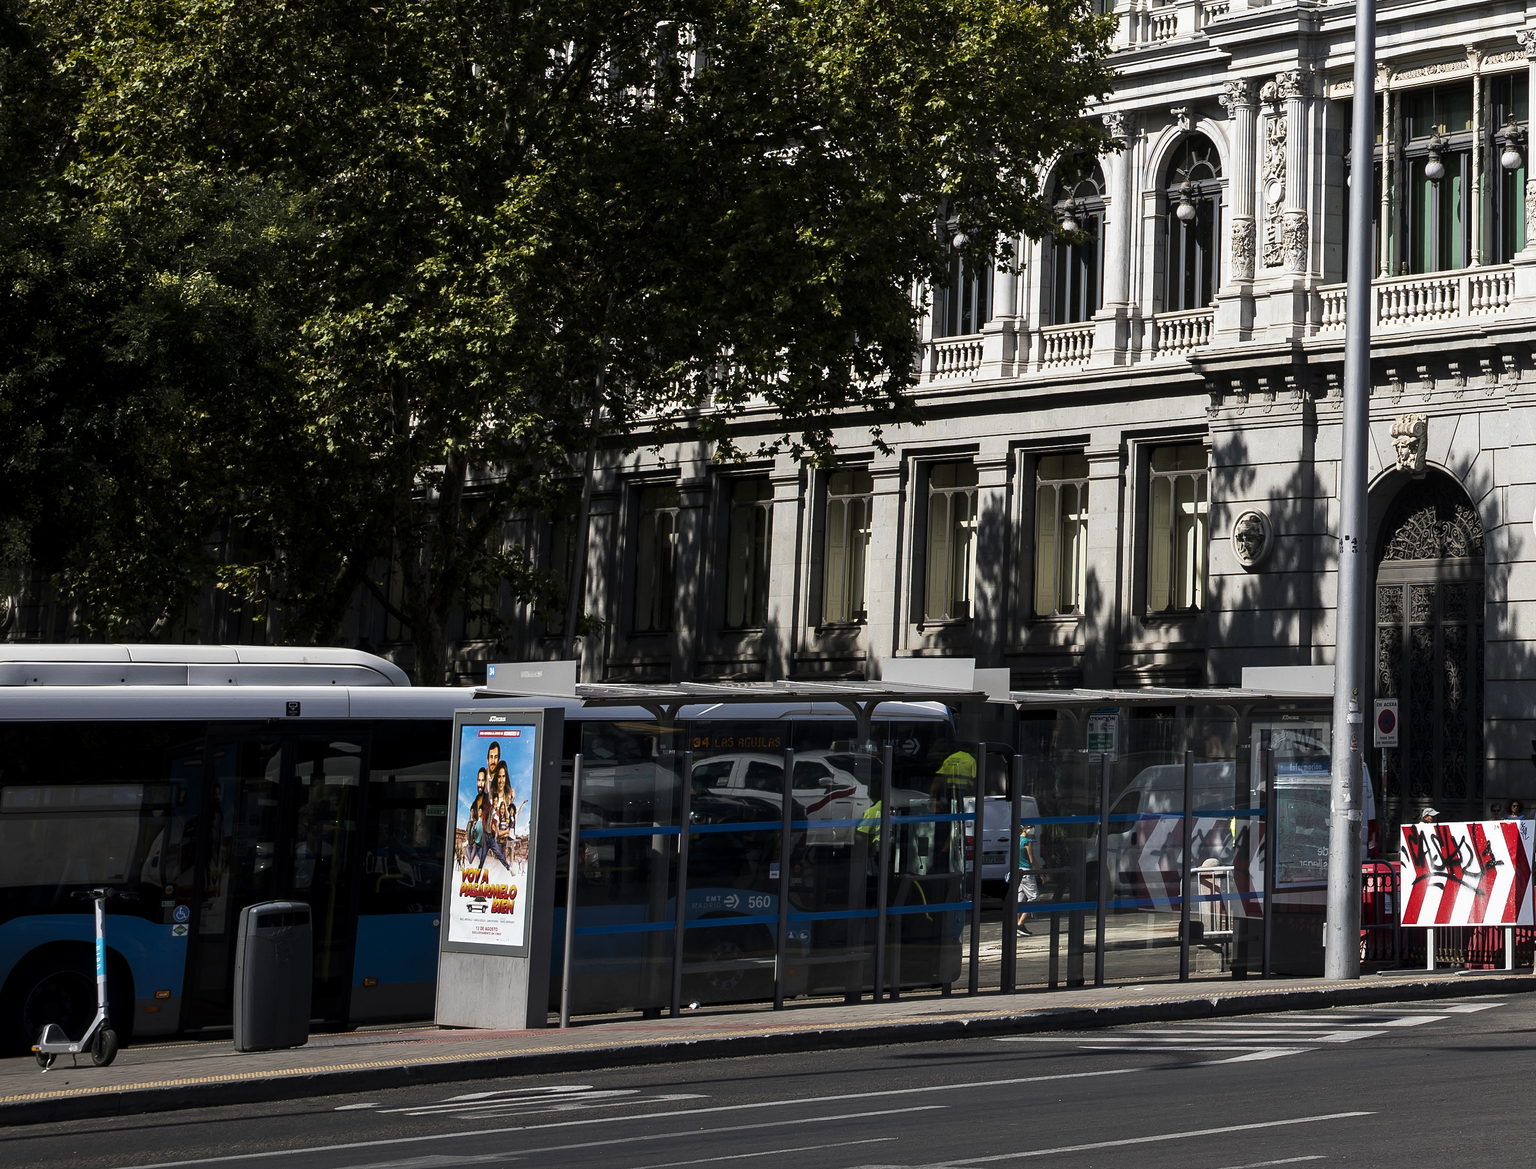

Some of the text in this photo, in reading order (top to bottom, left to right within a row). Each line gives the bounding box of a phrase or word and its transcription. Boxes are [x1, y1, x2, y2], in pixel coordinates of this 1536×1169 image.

[489, 667, 495, 676] 34
[693, 737, 781, 748] 34 LAS AGUILAS
[461, 868, 489, 884] VOY A
[459, 882, 518, 900] PASARMELO
[491, 899, 515, 915] BIEN
[748, 895, 771, 908] 560
